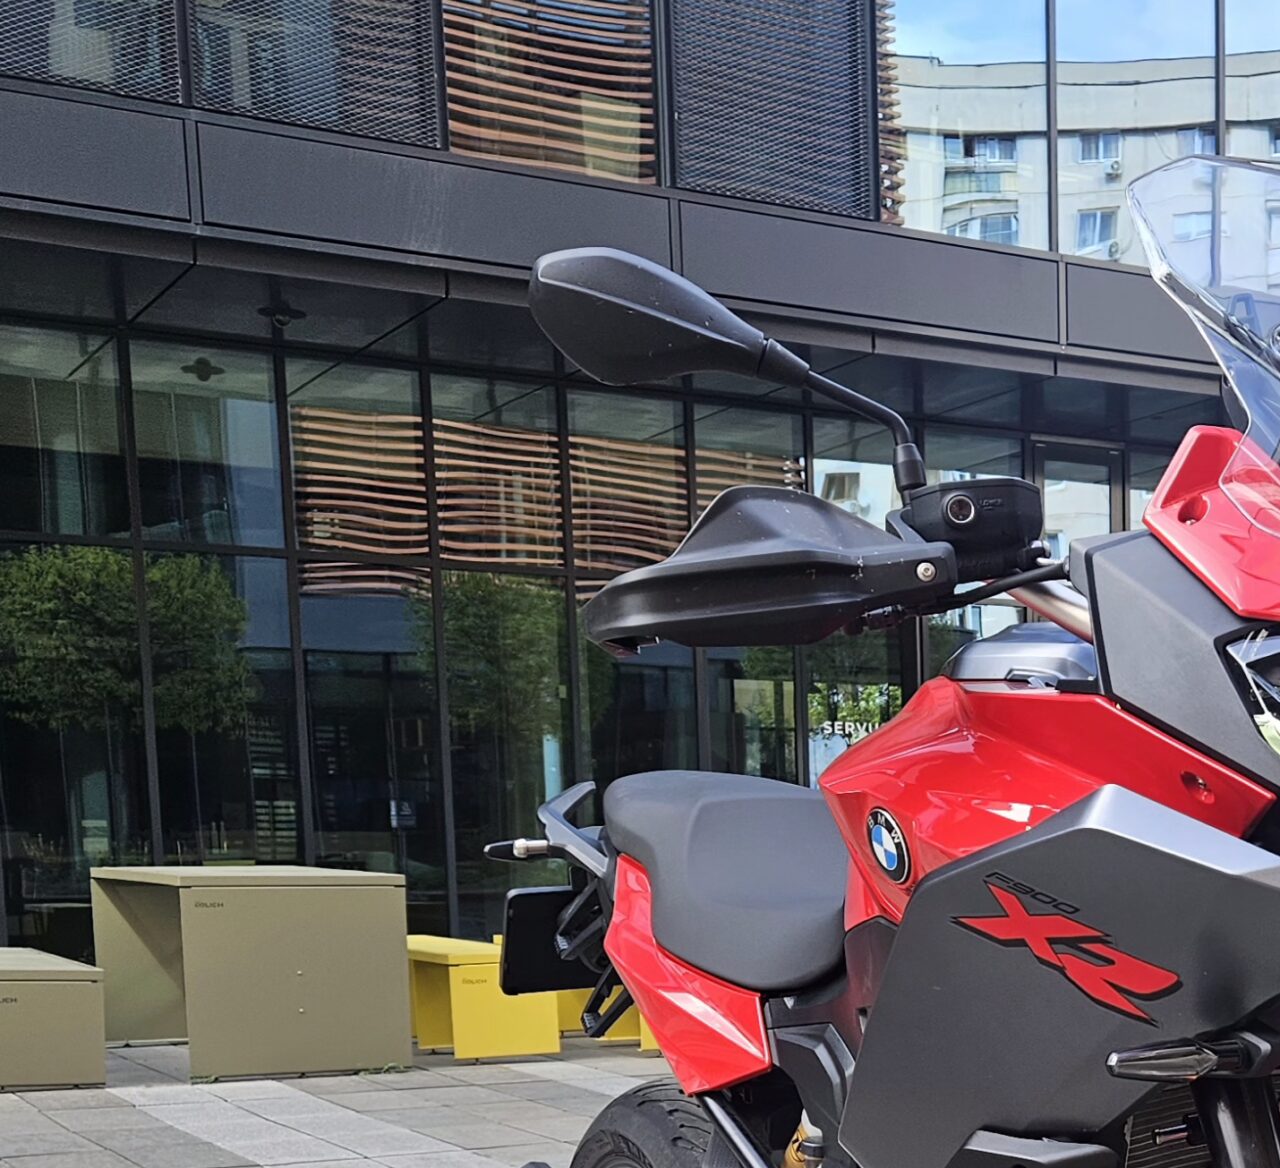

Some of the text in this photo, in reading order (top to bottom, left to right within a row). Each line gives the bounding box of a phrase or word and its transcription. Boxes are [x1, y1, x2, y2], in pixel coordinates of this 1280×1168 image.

[823, 720, 887, 735] SERVU
[868, 813, 901, 843] BMW
[985, 871, 1081, 915] F900
[950, 879, 1184, 1029] XR
